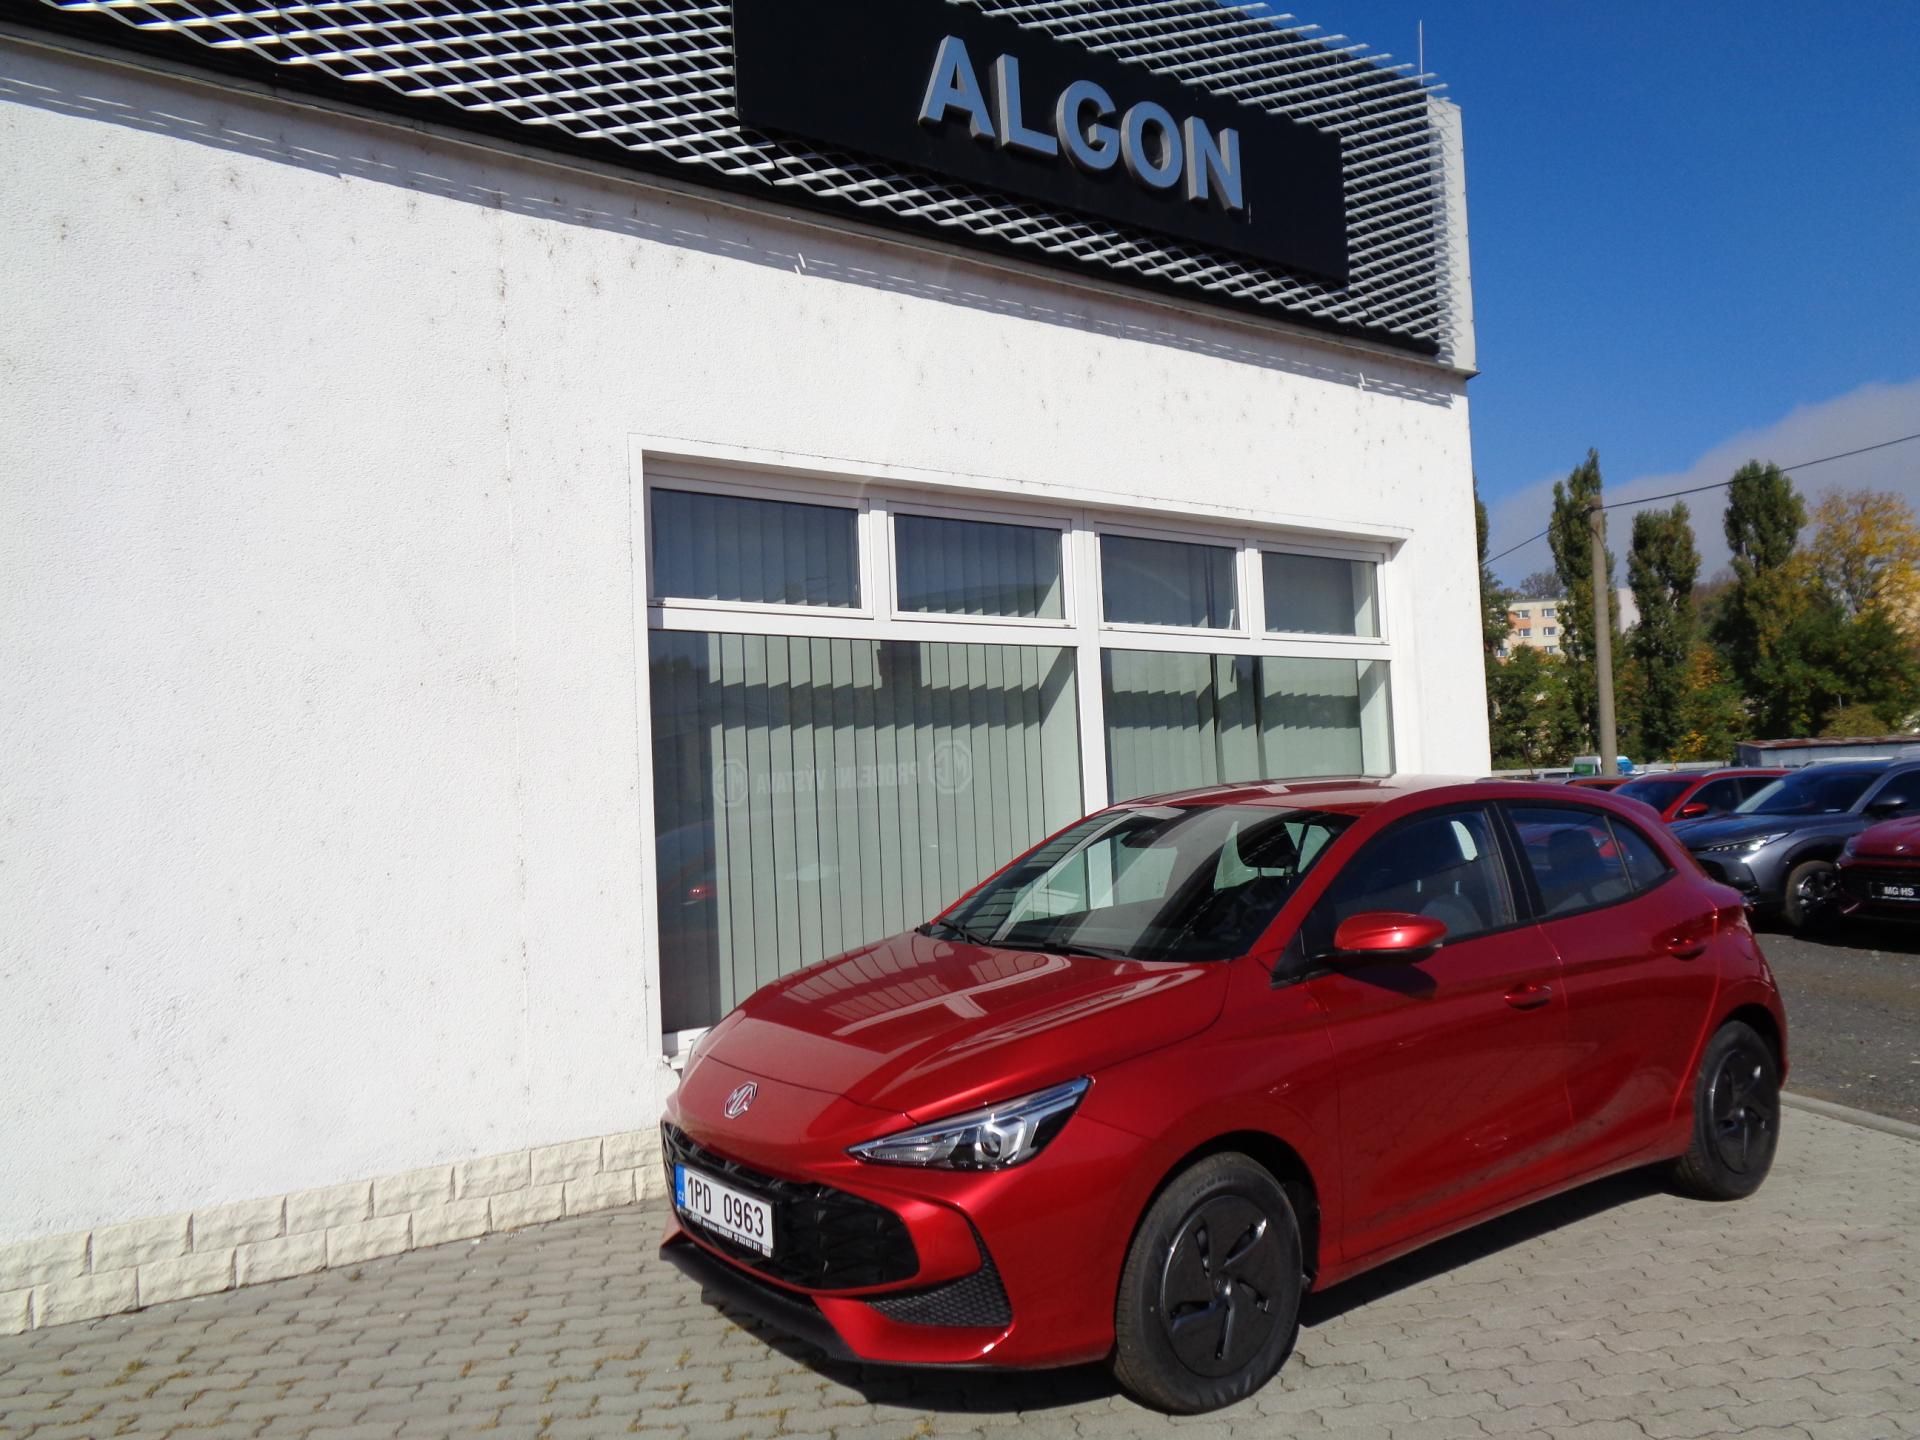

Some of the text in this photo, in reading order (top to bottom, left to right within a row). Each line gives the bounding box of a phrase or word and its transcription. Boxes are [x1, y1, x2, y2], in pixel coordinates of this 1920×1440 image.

[918, 34, 1243, 210] ALGON
[1884, 886, 1914, 896] MG HS
[688, 1177, 711, 1214] 1PD
[724, 1193, 764, 1238] 0963
